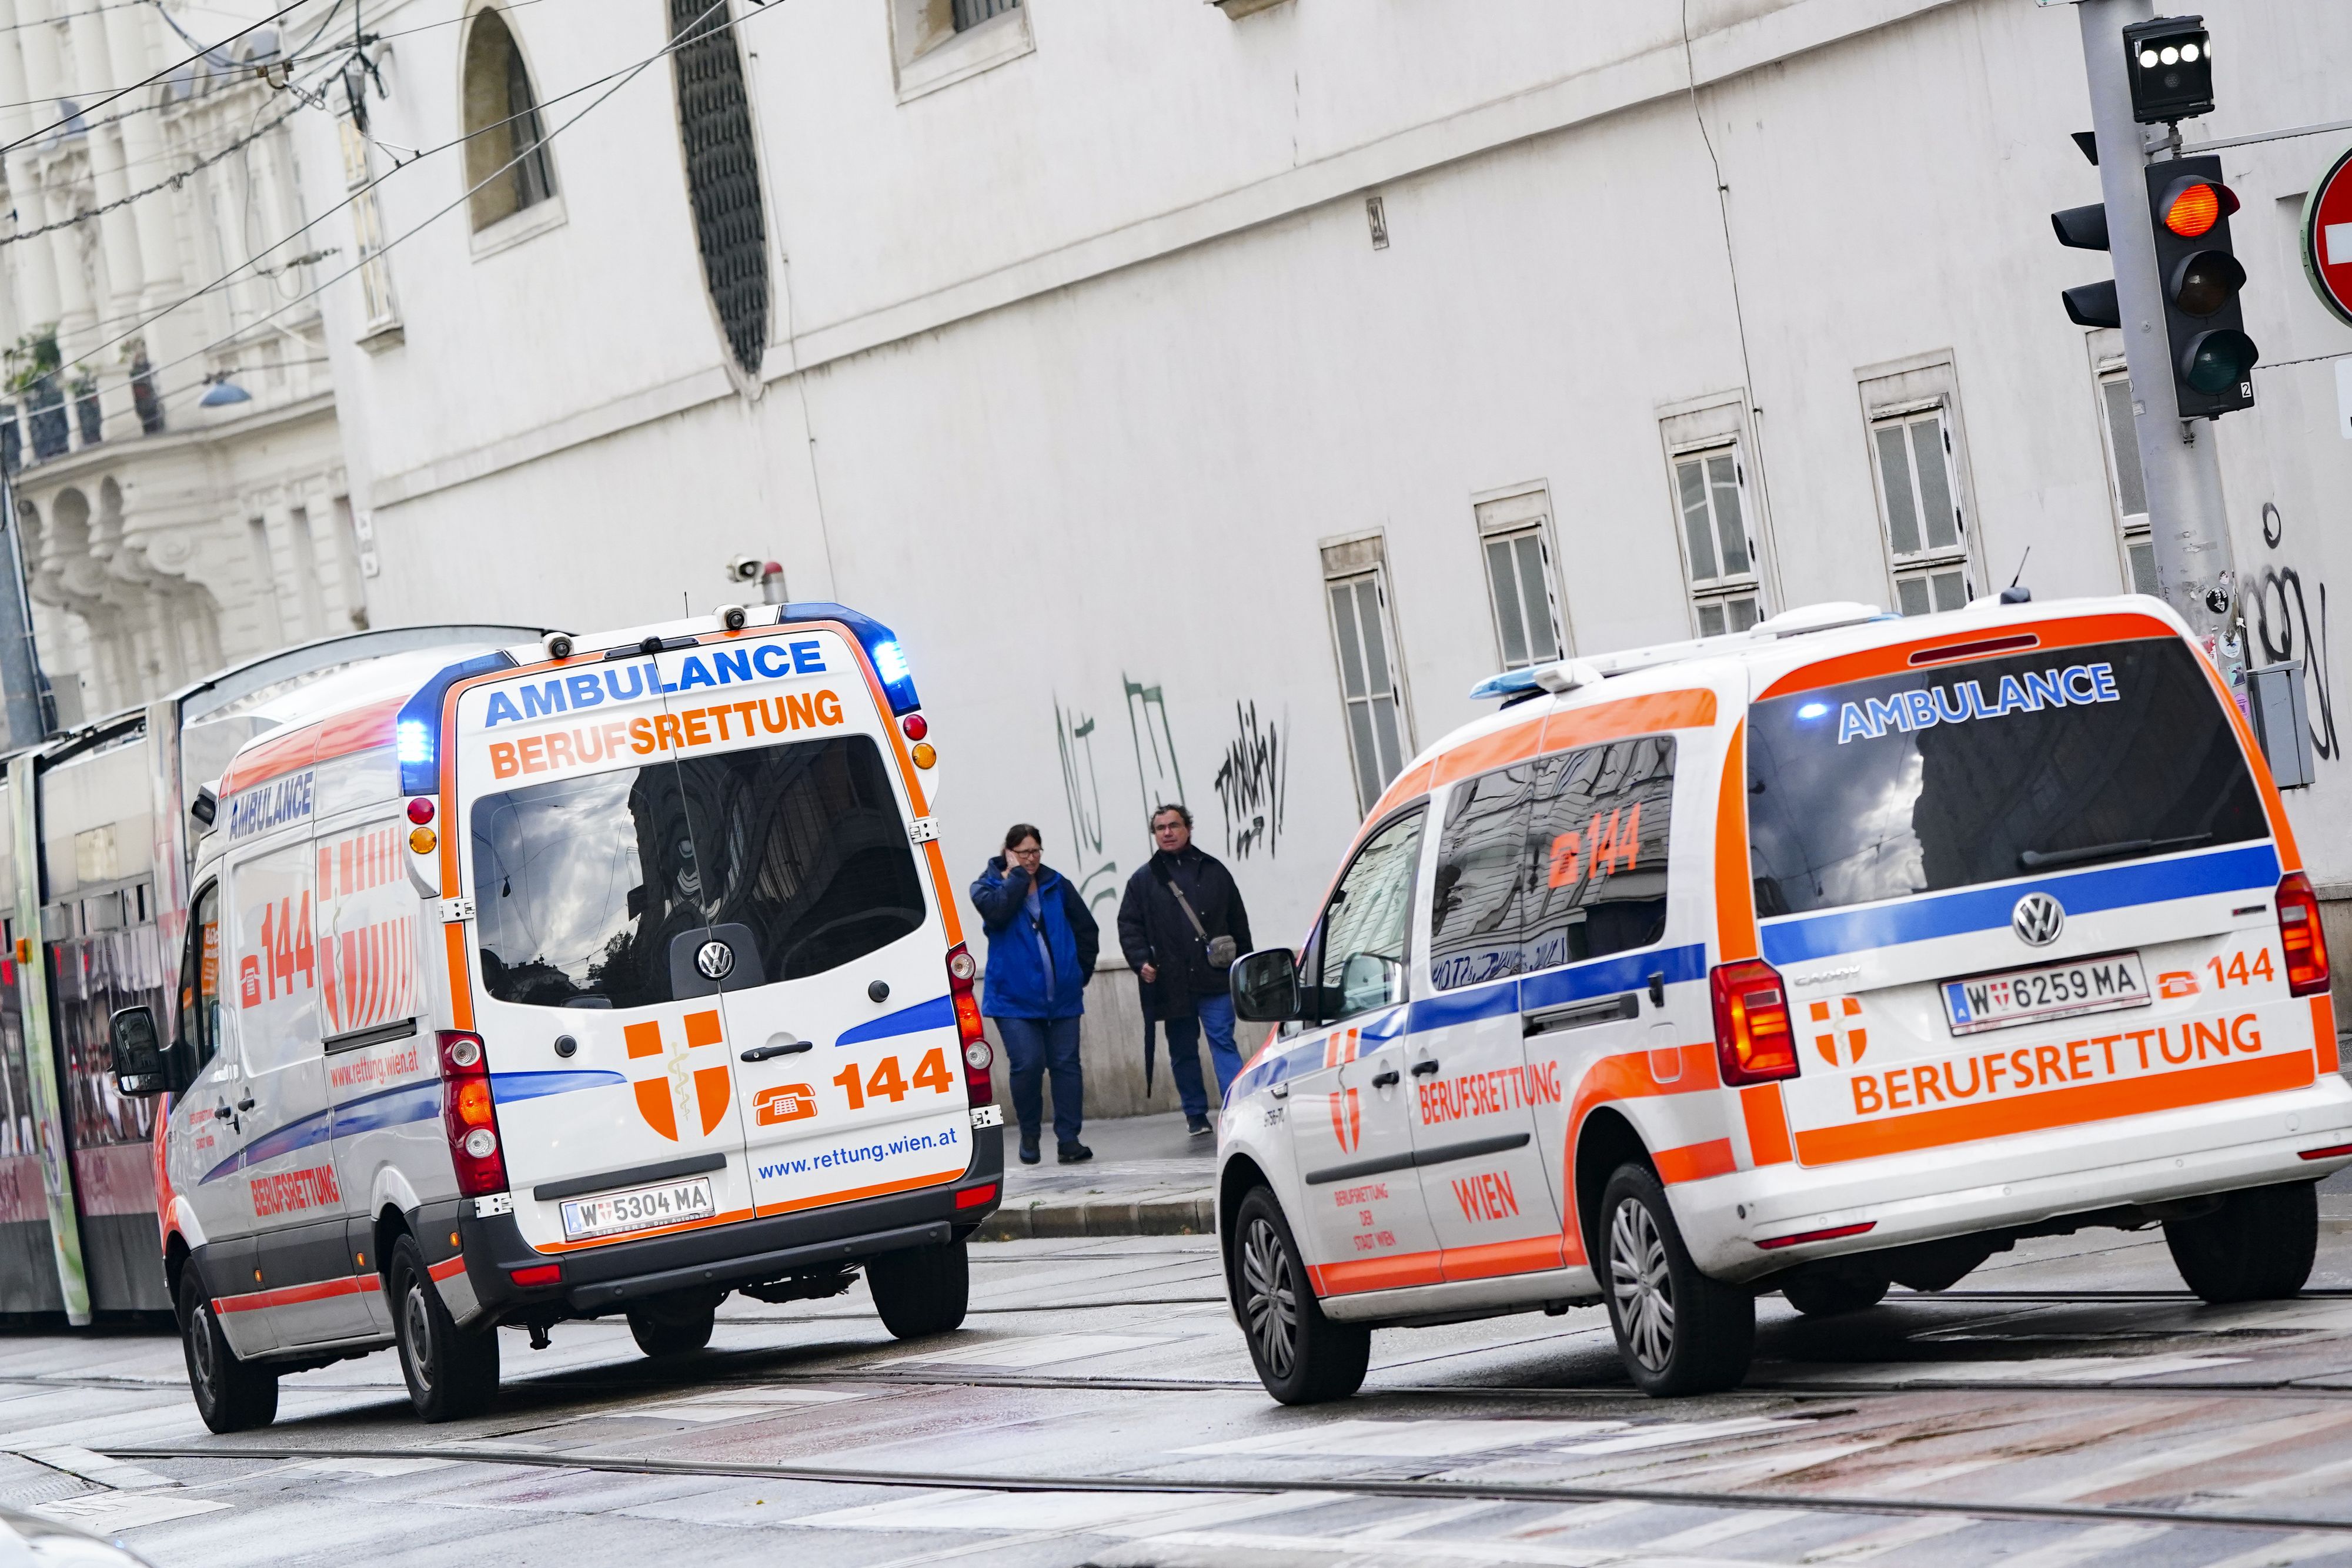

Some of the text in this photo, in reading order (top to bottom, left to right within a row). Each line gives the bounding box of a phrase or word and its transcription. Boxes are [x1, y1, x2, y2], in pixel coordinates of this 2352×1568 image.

[2243, 384, 2250, 396] 2
[485, 640, 826, 728] AMBULANCE
[1838, 662, 2120, 745] AMBULANCE
[489, 689, 844, 780] BERUFSRETTUNG
[229, 771, 313, 842] AMBULANCE
[1587, 803, 1641, 880] 144
[261, 890, 315, 1001] 144
[2206, 947, 2274, 989] 144
[1958, 964, 2137, 1018] A W 6259 MA
[330, 1045, 419, 1088] www.rettung.wien.at
[833, 1047, 954, 1110] 144
[1850, 1013, 2263, 1115] BERUFSRETTUNG
[1419, 1060, 1562, 1125] BERUFSRETTUNG
[758, 1128, 958, 1179] www.rettung.wien.at
[250, 1164, 340, 1217] BERUFSRETTUNG
[580, 1203, 597, 1226] W
[612, 1192, 670, 1221] 5304
[674, 1185, 707, 1211] MA
[1451, 1171, 1519, 1223] WIEN
[654, 1218, 668, 1226] Das
[671, 1212, 709, 1223] Autohaus
[1375, 1231, 1396, 1246] WIEN
